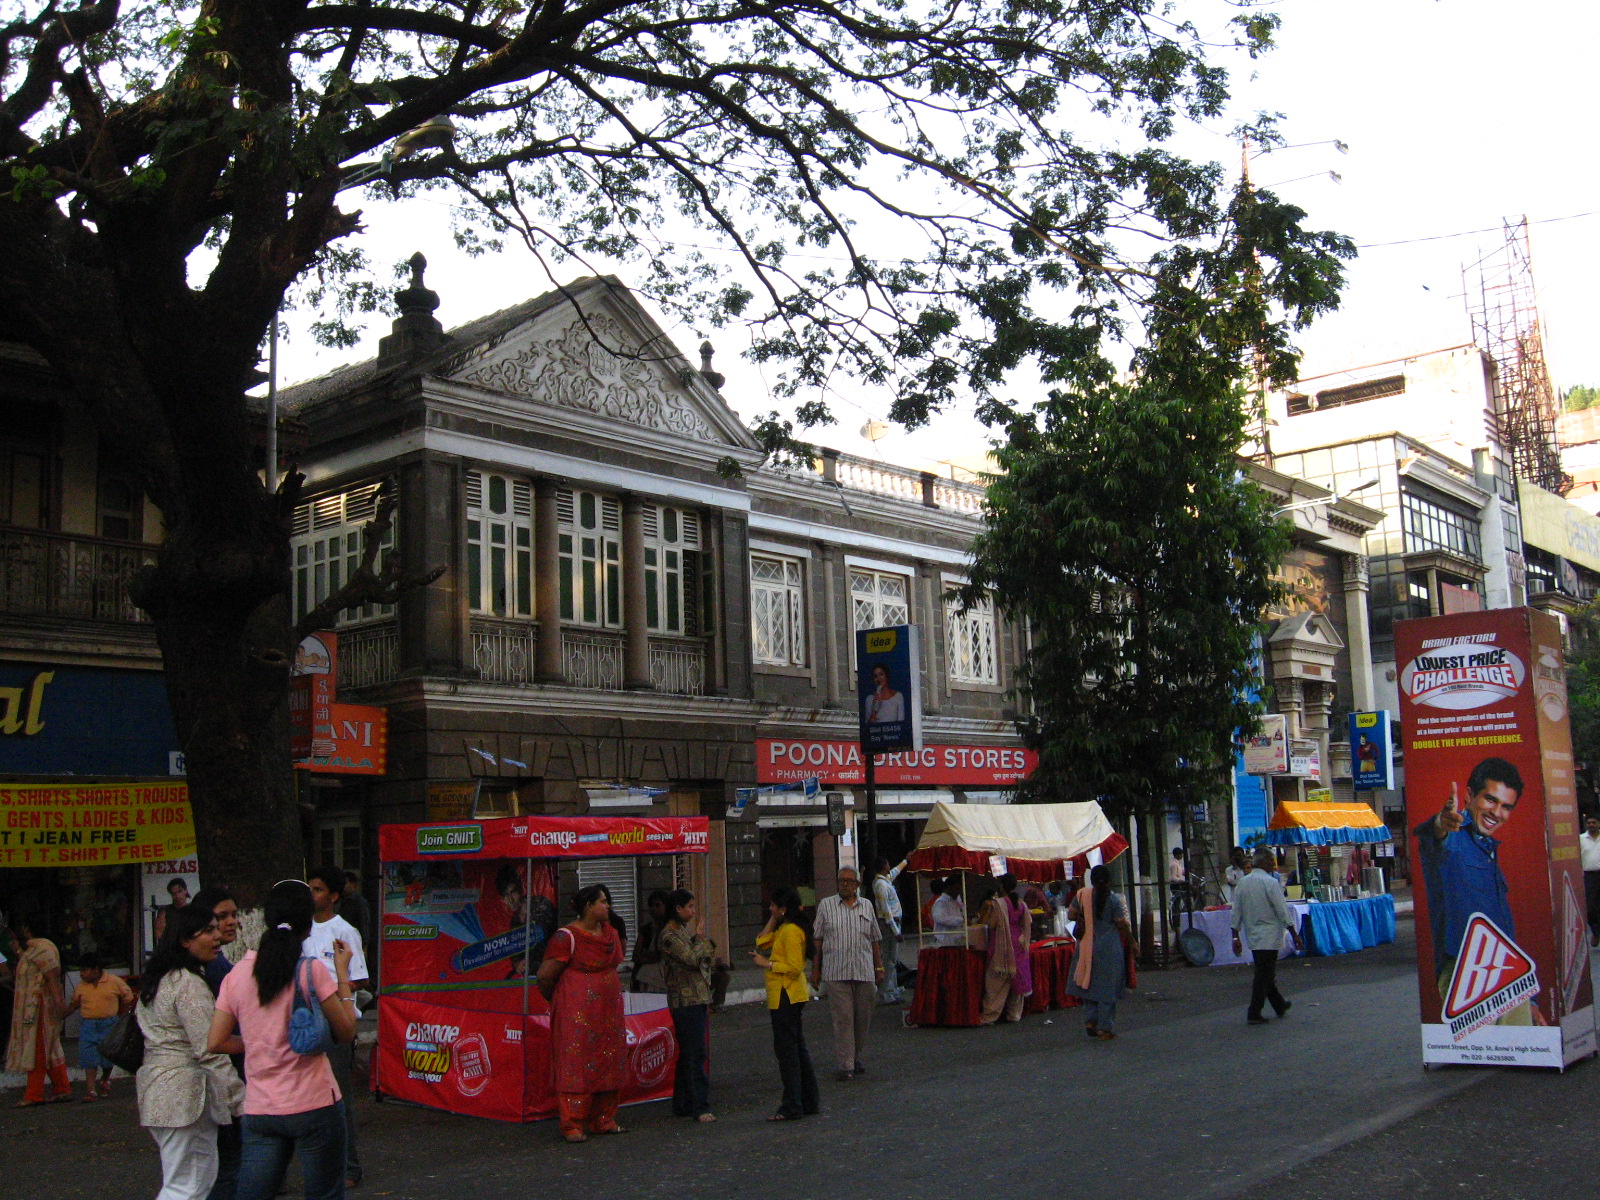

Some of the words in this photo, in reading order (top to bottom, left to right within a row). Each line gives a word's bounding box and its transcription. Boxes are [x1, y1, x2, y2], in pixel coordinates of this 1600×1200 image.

[1421, 637, 1452, 649] BRAND
[1452, 633, 1497, 646] FACTORY
[1414, 655, 1465, 672] LOWEST
[1468, 647, 1507, 668] PRICE
[1411, 665, 1517, 696] CHALLENGE
[1417, 717, 1429, 725] Find
[1456, 714, 1479, 722] product
[1496, 711, 1515, 719] brand
[1412, 740, 1441, 750] DOUBLE
[1441, 738, 1455, 748] THE
[1455, 736, 1478, 747] PRICE
[770, 742, 862, 767] POONA
[944, 748, 1026, 769] STORES
[776, 769, 829, 780] PHARMACY
[72, 809, 129, 828] LADIES
[135, 809, 147, 826] &
[34, 831, 83, 845] JEAN
[90, 829, 136, 844] FREE
[421, 833, 443, 846] Join
[446, 831, 476, 845] GNIIT
[530, 830, 577, 850] Change
[609, 826, 646, 845] world
[684, 831, 708, 845] NIIT
[58, 847, 110, 862] SHIRT
[118, 844, 165, 860] FREE
[144, 860, 198, 875] TEXAS
[386, 927, 406, 937] Join
[408, 927, 434, 936] GNIIT
[1452, 923, 1519, 1013] BF
[1450, 1004, 1486, 1034] BRAND
[1486, 973, 1537, 1013] FACTORY
[1453, 1028, 1468, 1042] BEST
[1468, 1016, 1493, 1035] BRANDS
[1496, 1001, 1517, 1019] SMART
[1517, 987, 1539, 1006] PRICES
[405, 1022, 460, 1049] Change
[402, 1044, 452, 1074] world
[424, 1073, 442, 1084] you
